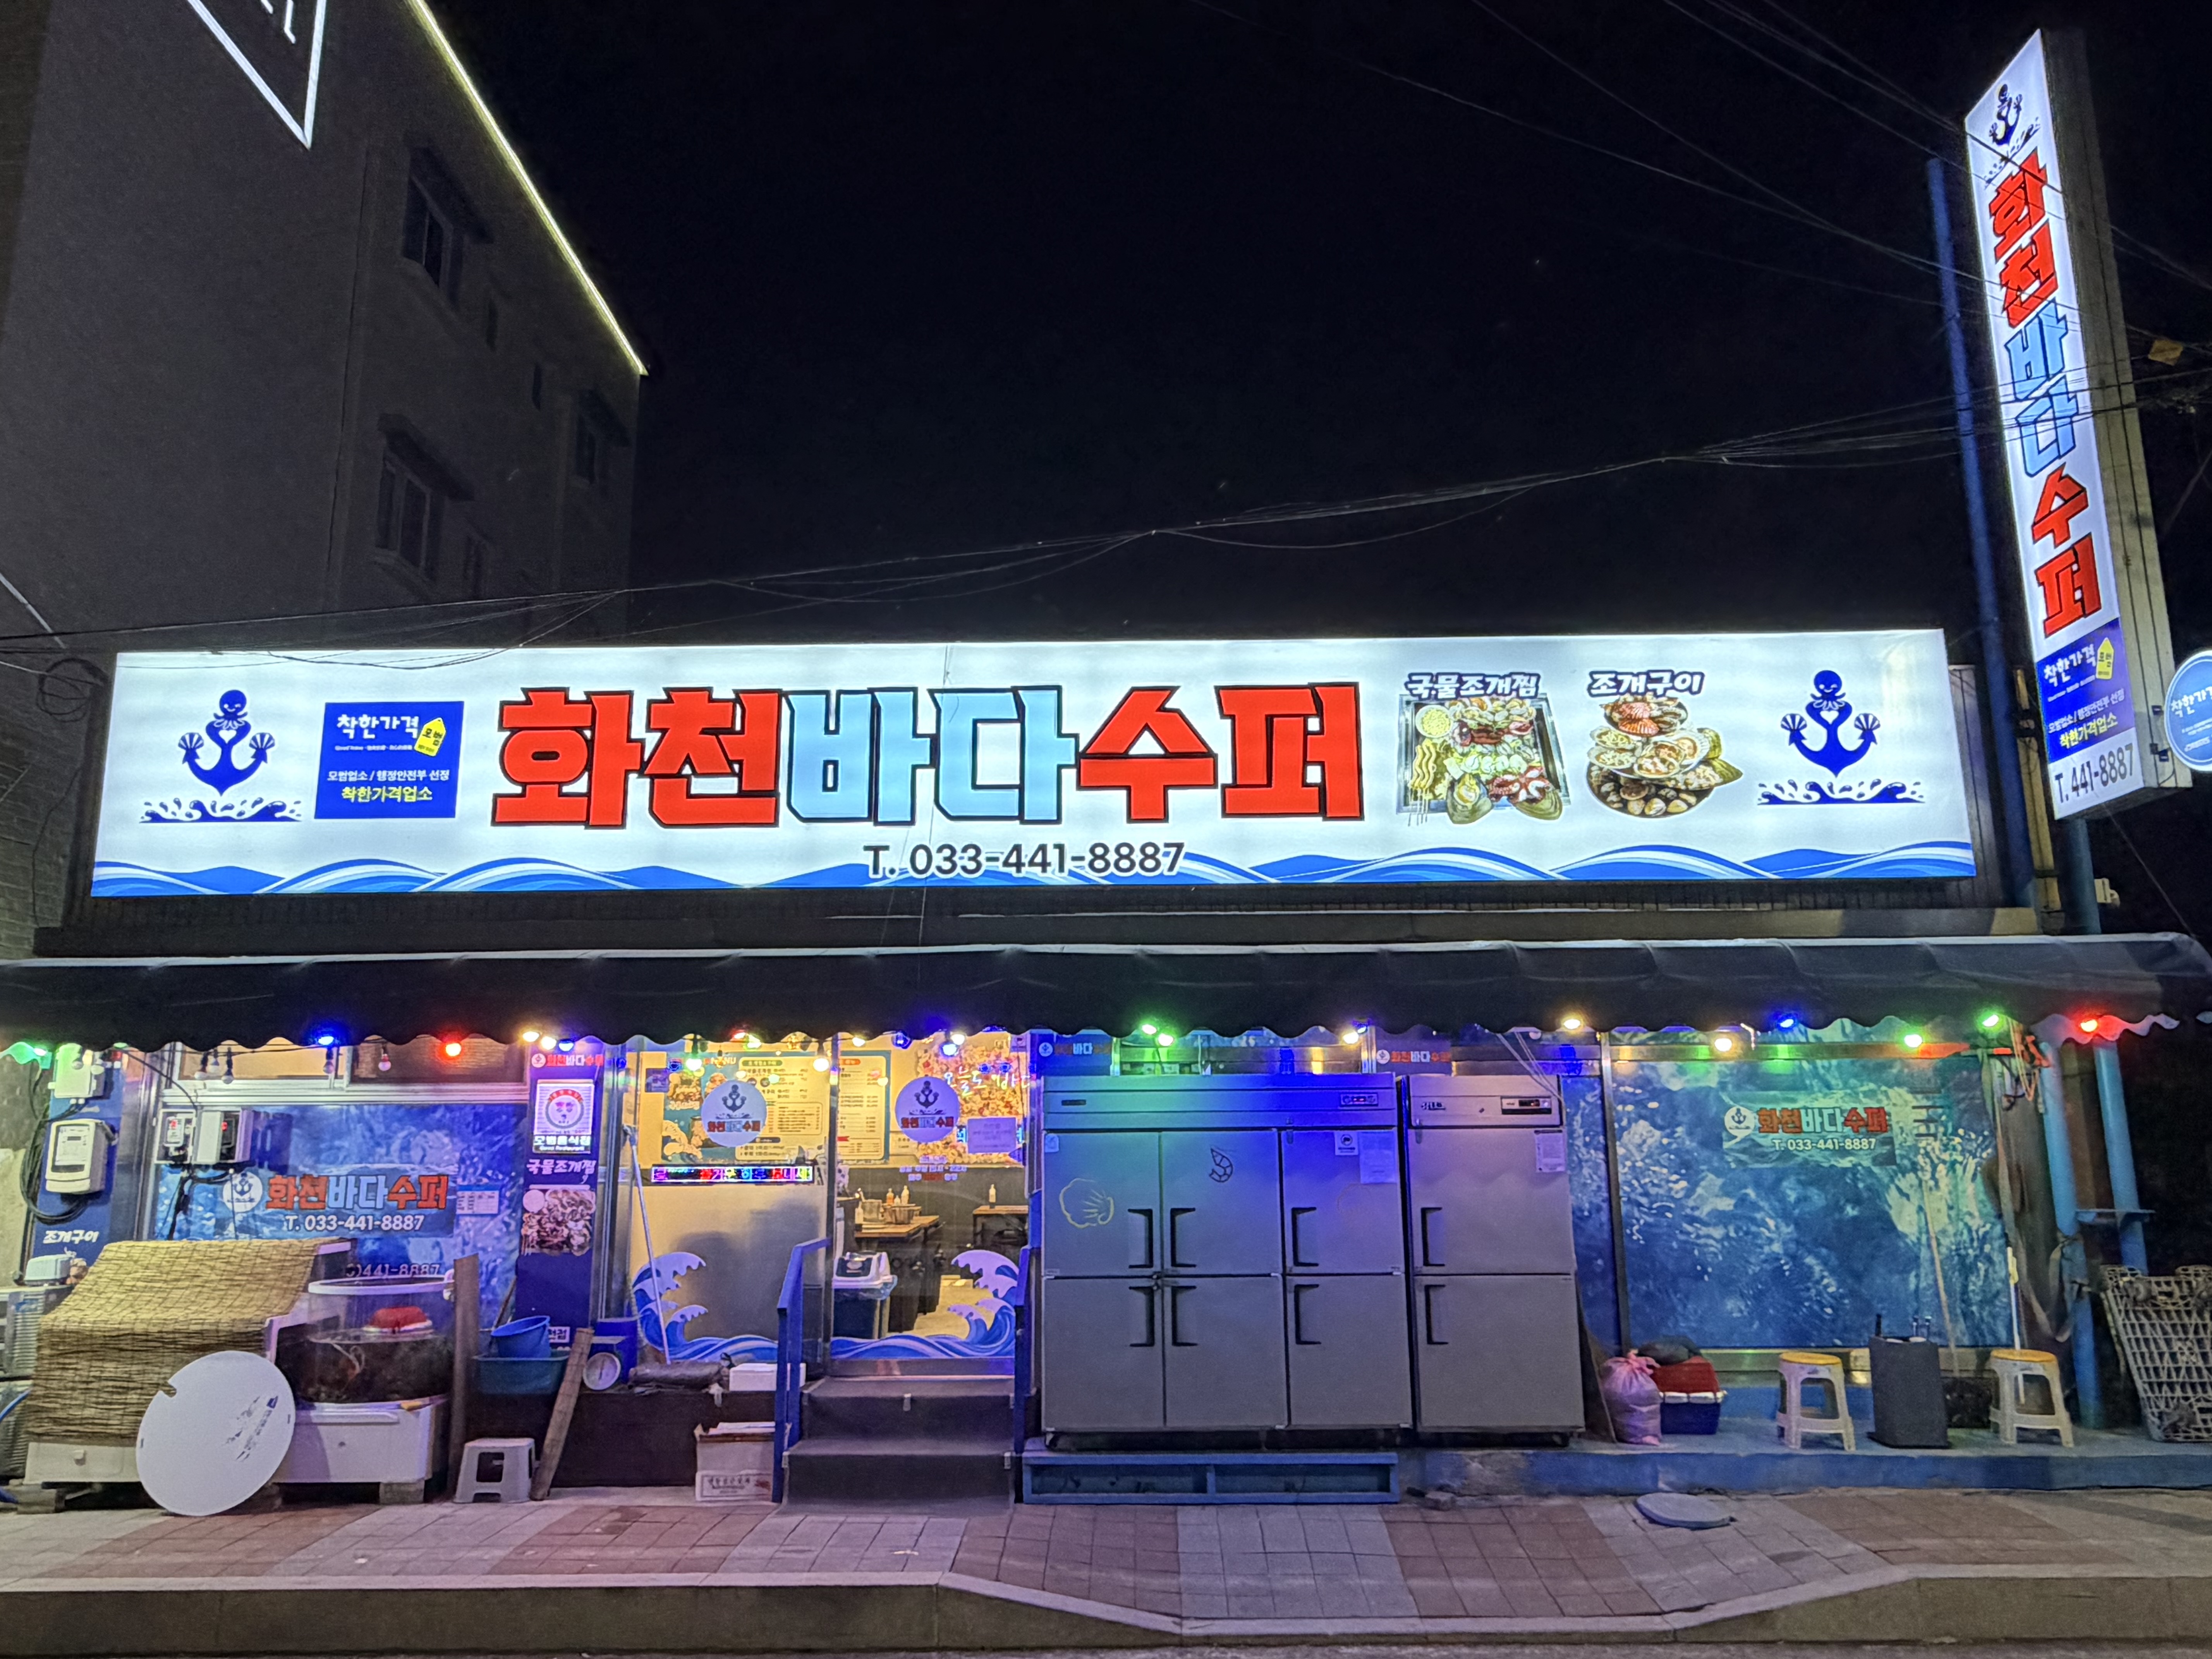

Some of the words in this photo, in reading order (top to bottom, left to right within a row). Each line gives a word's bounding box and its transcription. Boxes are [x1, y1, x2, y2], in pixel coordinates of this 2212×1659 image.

[1988, 146, 2102, 639] 화천바다수퍼
[2044, 643, 2096, 687] 착한가격
[1407, 673, 1540, 698] 국물조개찜
[1589, 670, 1703, 696] 조개구이
[337, 714, 419, 739] 착한가격
[2060, 712, 2118, 748] 착한가격업소
[491, 682, 1365, 829] 화천바다수퍼
[328, 770, 368, 782] 모범업소
[429, 769, 450, 781] 선정
[2055, 772, 2069, 804] T.
[2071, 744, 2134, 797] 441-8887
[342, 786, 433, 803] 착한가격업소
[863, 845, 898, 876] T.
[908, 842, 1186, 877] 033-441-8887
[1756, 1106, 1889, 1134] 화천바다수퍼
[1787, 1138, 1876, 1150] 033-441-8887
[526, 1159, 597, 1175] 국물조개찜
[265, 1175, 449, 1210] 화천바다수퍼
[285, 1215, 300, 1230] T.
[305, 1214, 425, 1231] 033-441-8887
[43, 1229, 100, 1245] 조개구이
